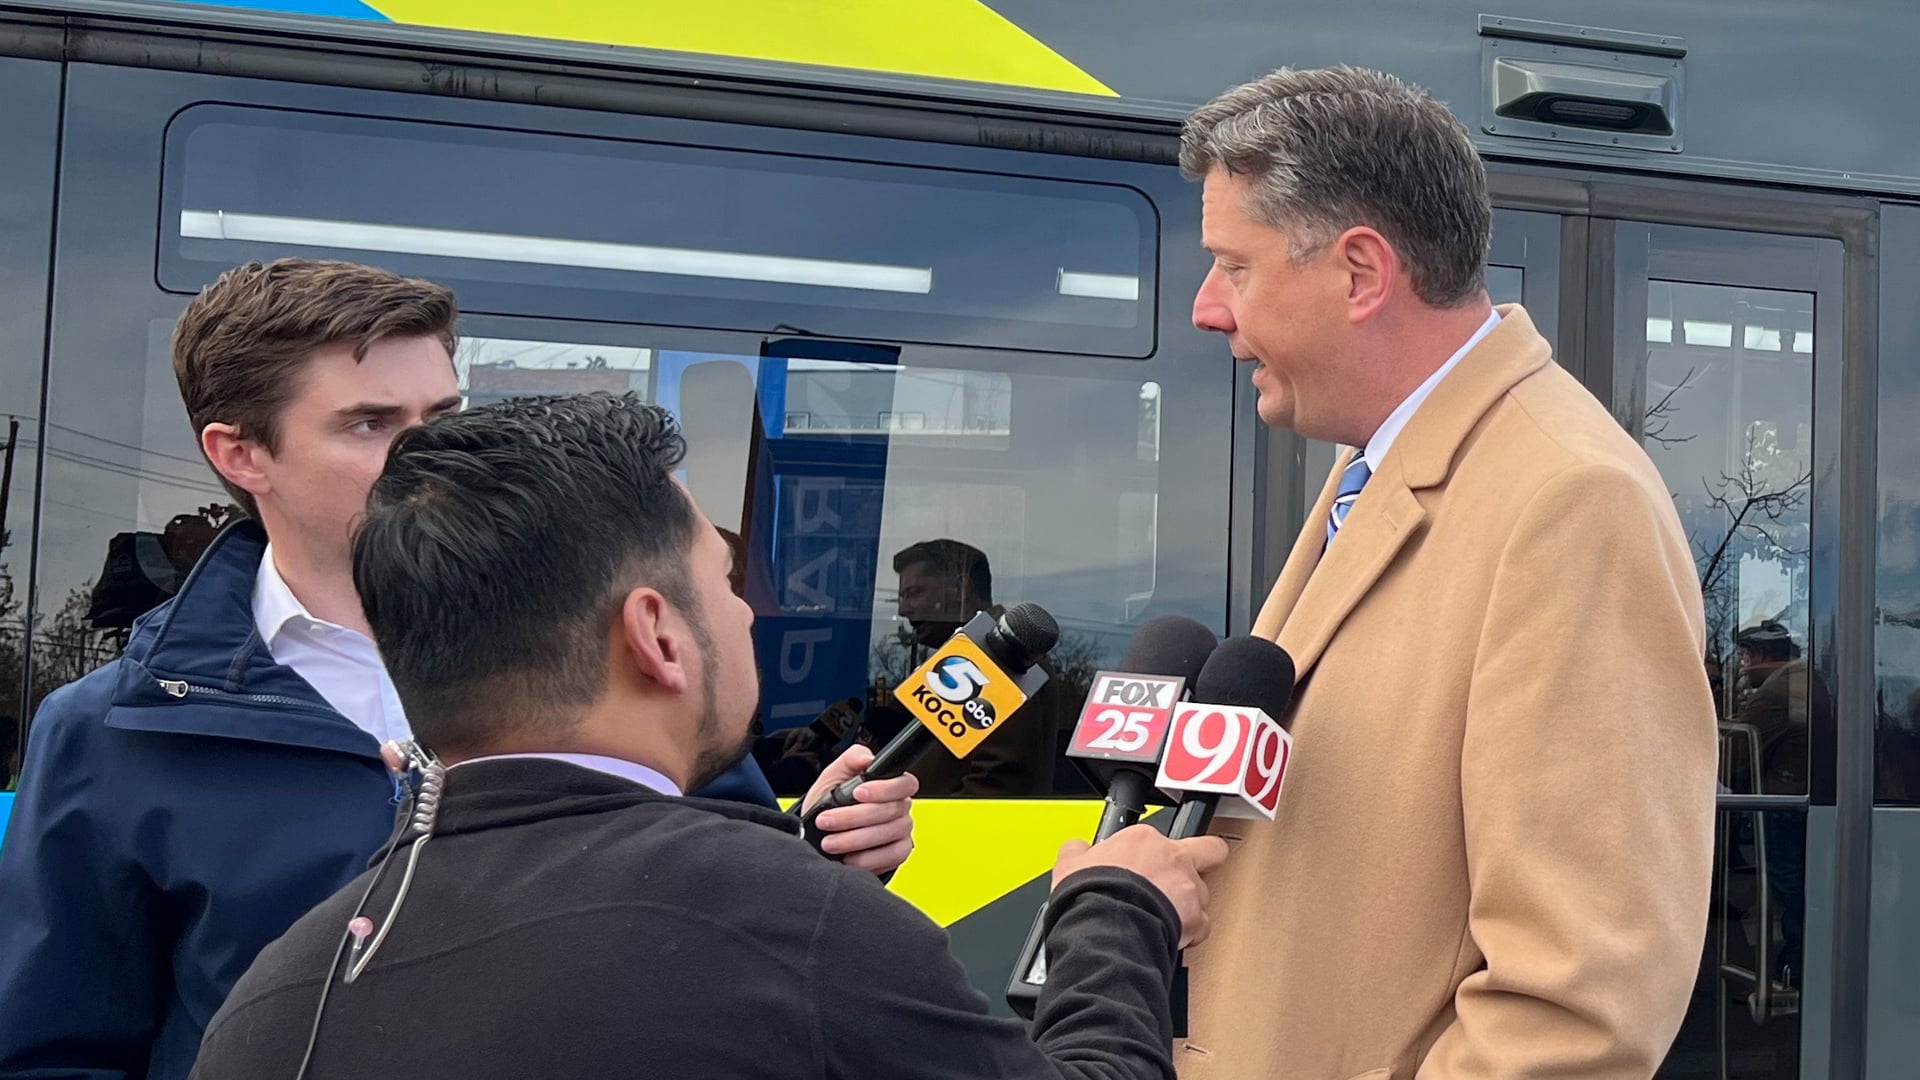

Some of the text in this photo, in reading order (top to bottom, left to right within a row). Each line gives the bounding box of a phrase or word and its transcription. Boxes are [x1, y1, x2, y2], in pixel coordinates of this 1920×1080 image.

[925, 657, 990, 703] 5
[1102, 680, 1167, 707] FOX
[911, 685, 966, 738] KOCO
[965, 699, 993, 728] abc
[1087, 709, 1154, 752] 25
[1182, 707, 1242, 783] 9
[1254, 724, 1284, 803] 9
